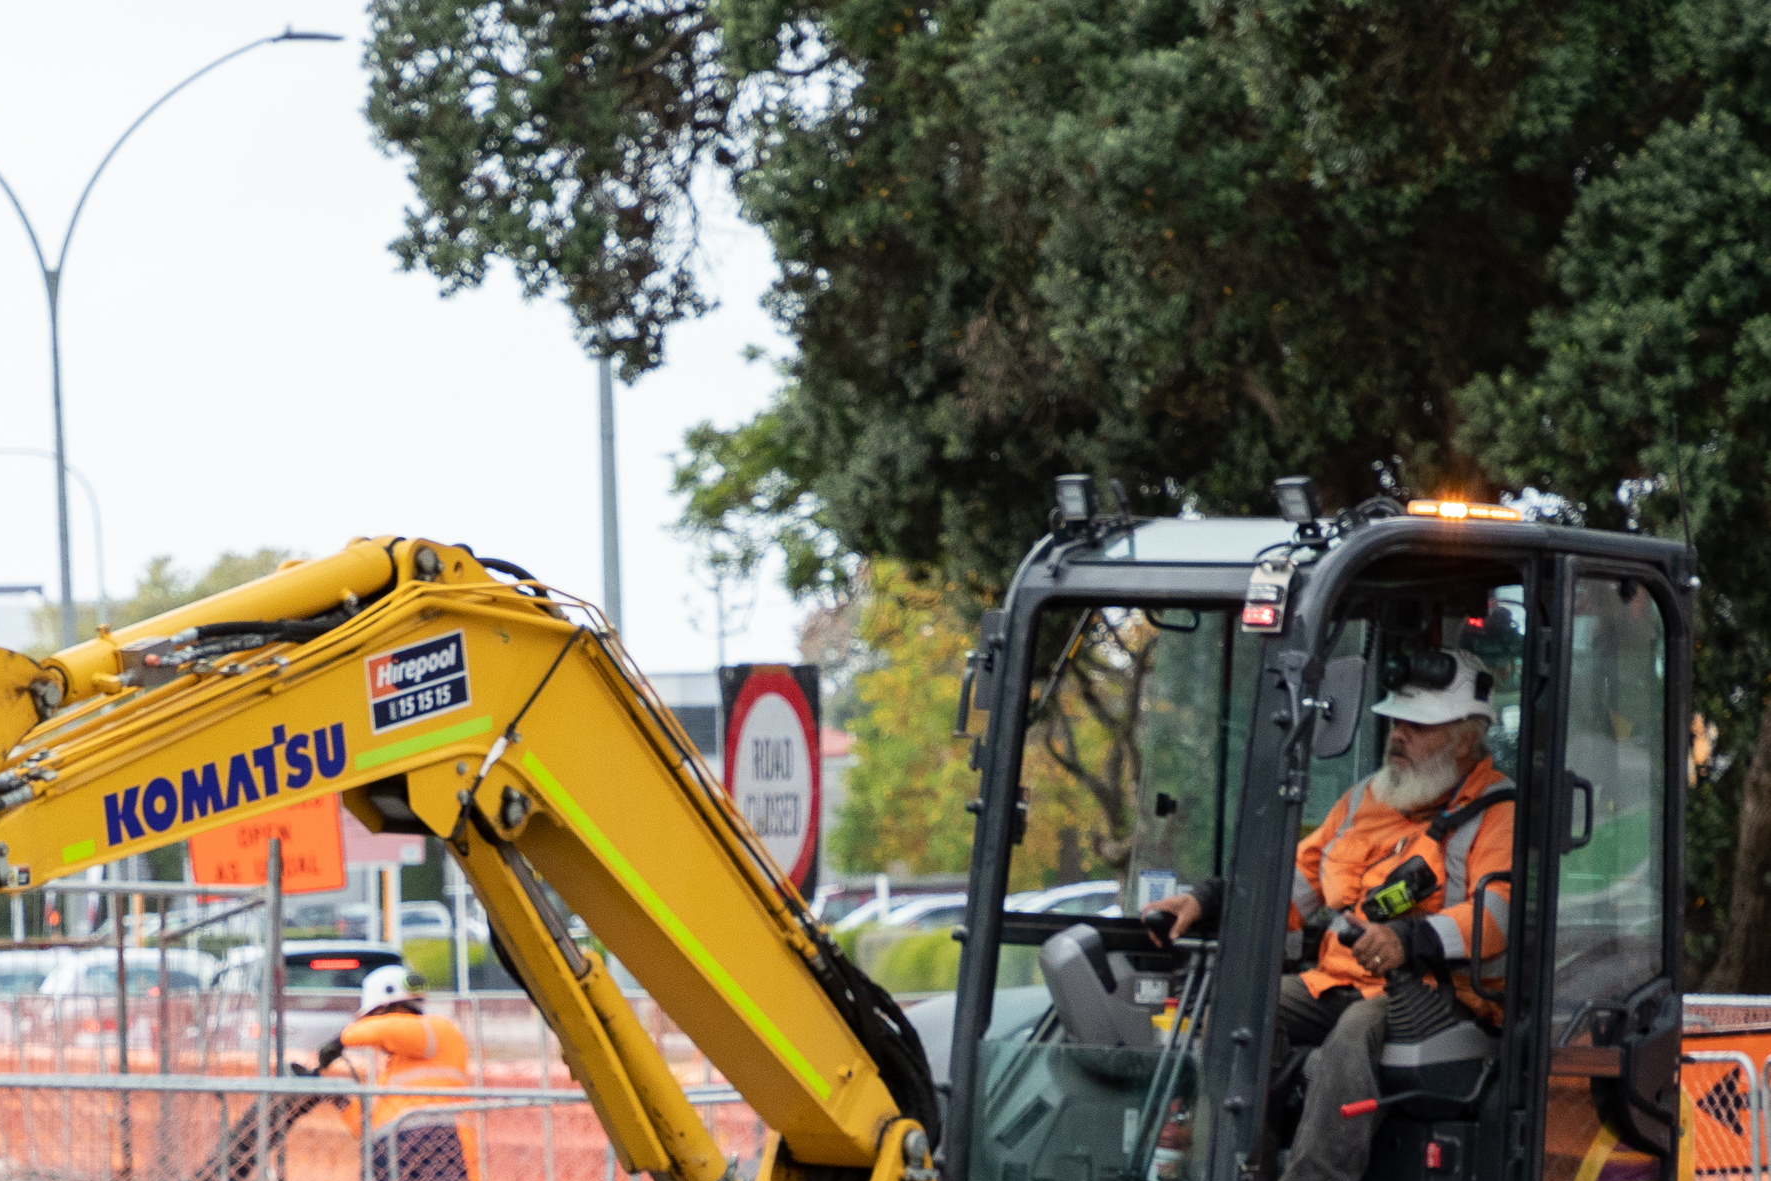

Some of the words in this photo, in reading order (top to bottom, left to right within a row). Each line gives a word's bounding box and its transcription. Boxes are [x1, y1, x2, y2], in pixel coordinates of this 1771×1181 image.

[376, 642, 458, 688] Hirepool
[399, 696, 415, 717] 15
[417, 690, 434, 711] 15
[435, 684, 451, 706] 15
[752, 738, 794, 780] ROAD
[104, 722, 347, 846] KOMATSU
